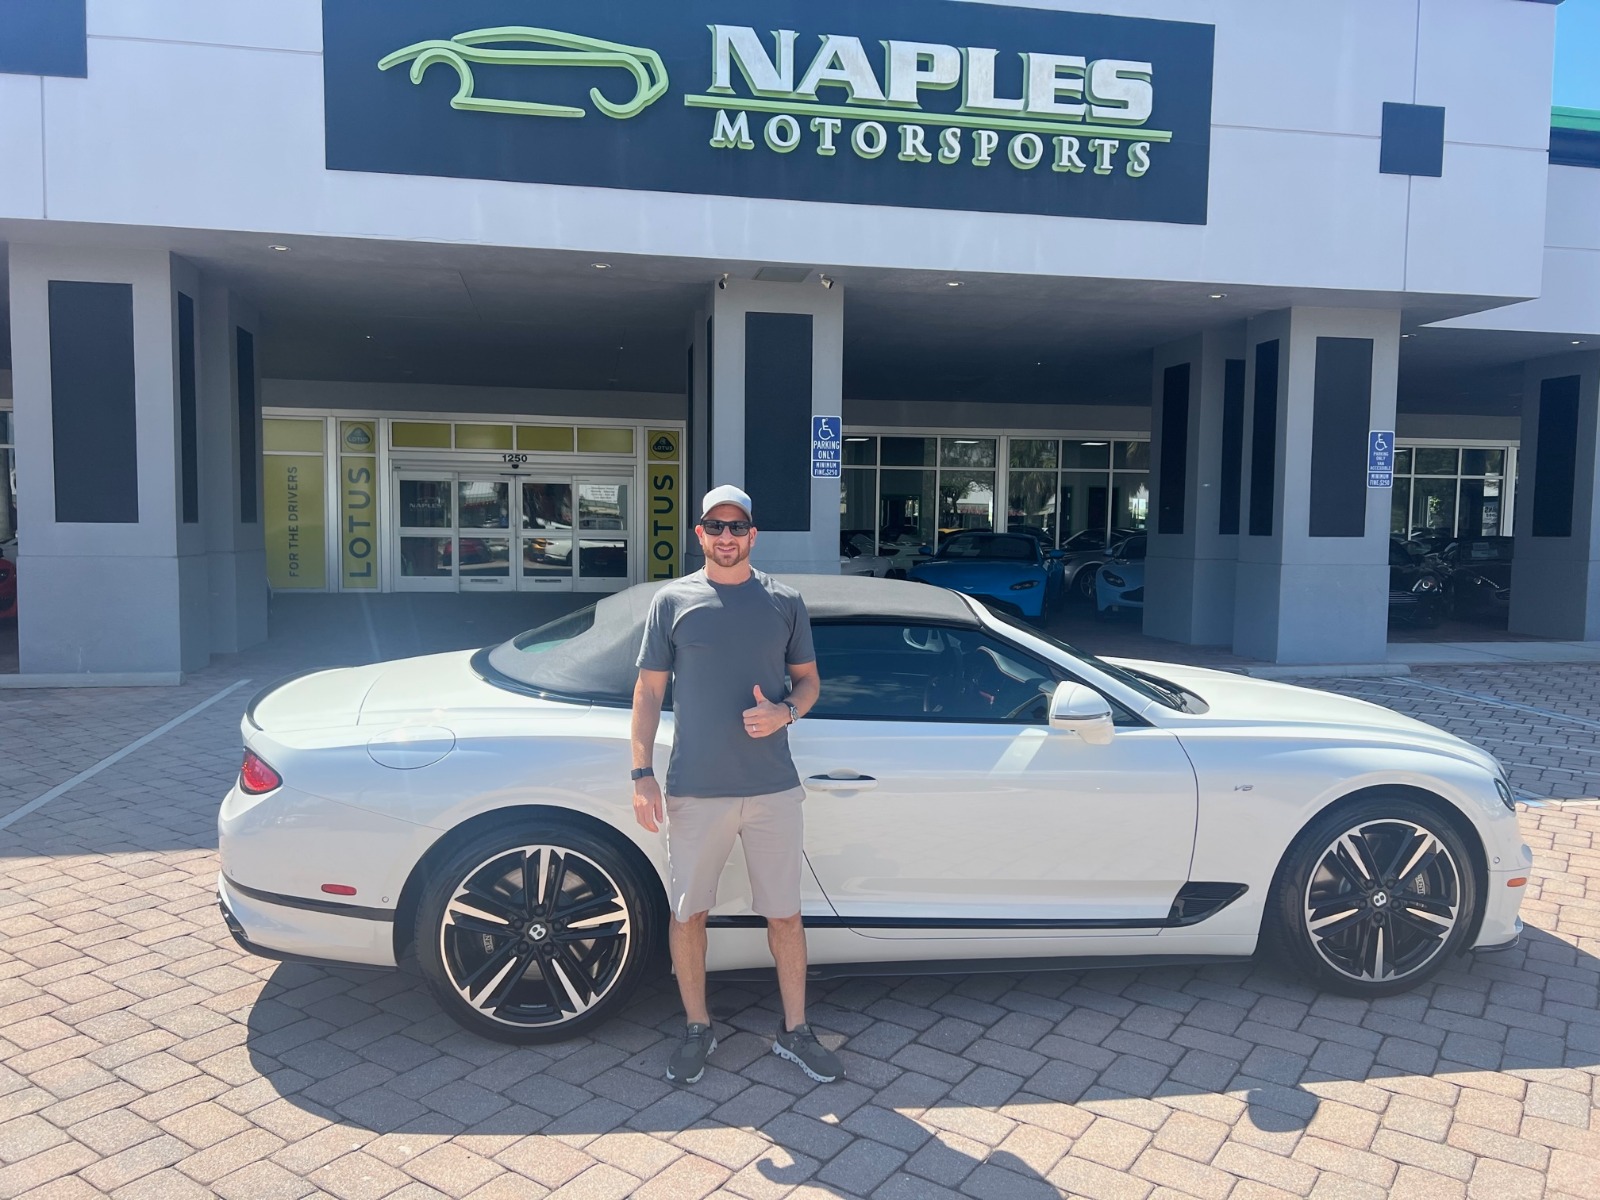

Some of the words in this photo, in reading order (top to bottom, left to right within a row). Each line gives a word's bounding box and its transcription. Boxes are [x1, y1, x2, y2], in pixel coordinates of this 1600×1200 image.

[706, 24, 1154, 126] NAPLES
[709, 109, 1151, 178] MOTORSPORTS
[502, 453, 528, 463] 1250
[813, 441, 840, 449] PARKING
[818, 451, 834, 459] ONLY
[287, 466, 299, 522] DRIVERS
[347, 467, 372, 578] LOTUS
[653, 474, 674, 580] LOTUS
[288, 525, 299, 549] THE
[288, 551, 299, 578] FOR
[528, 923, 547, 940] B
